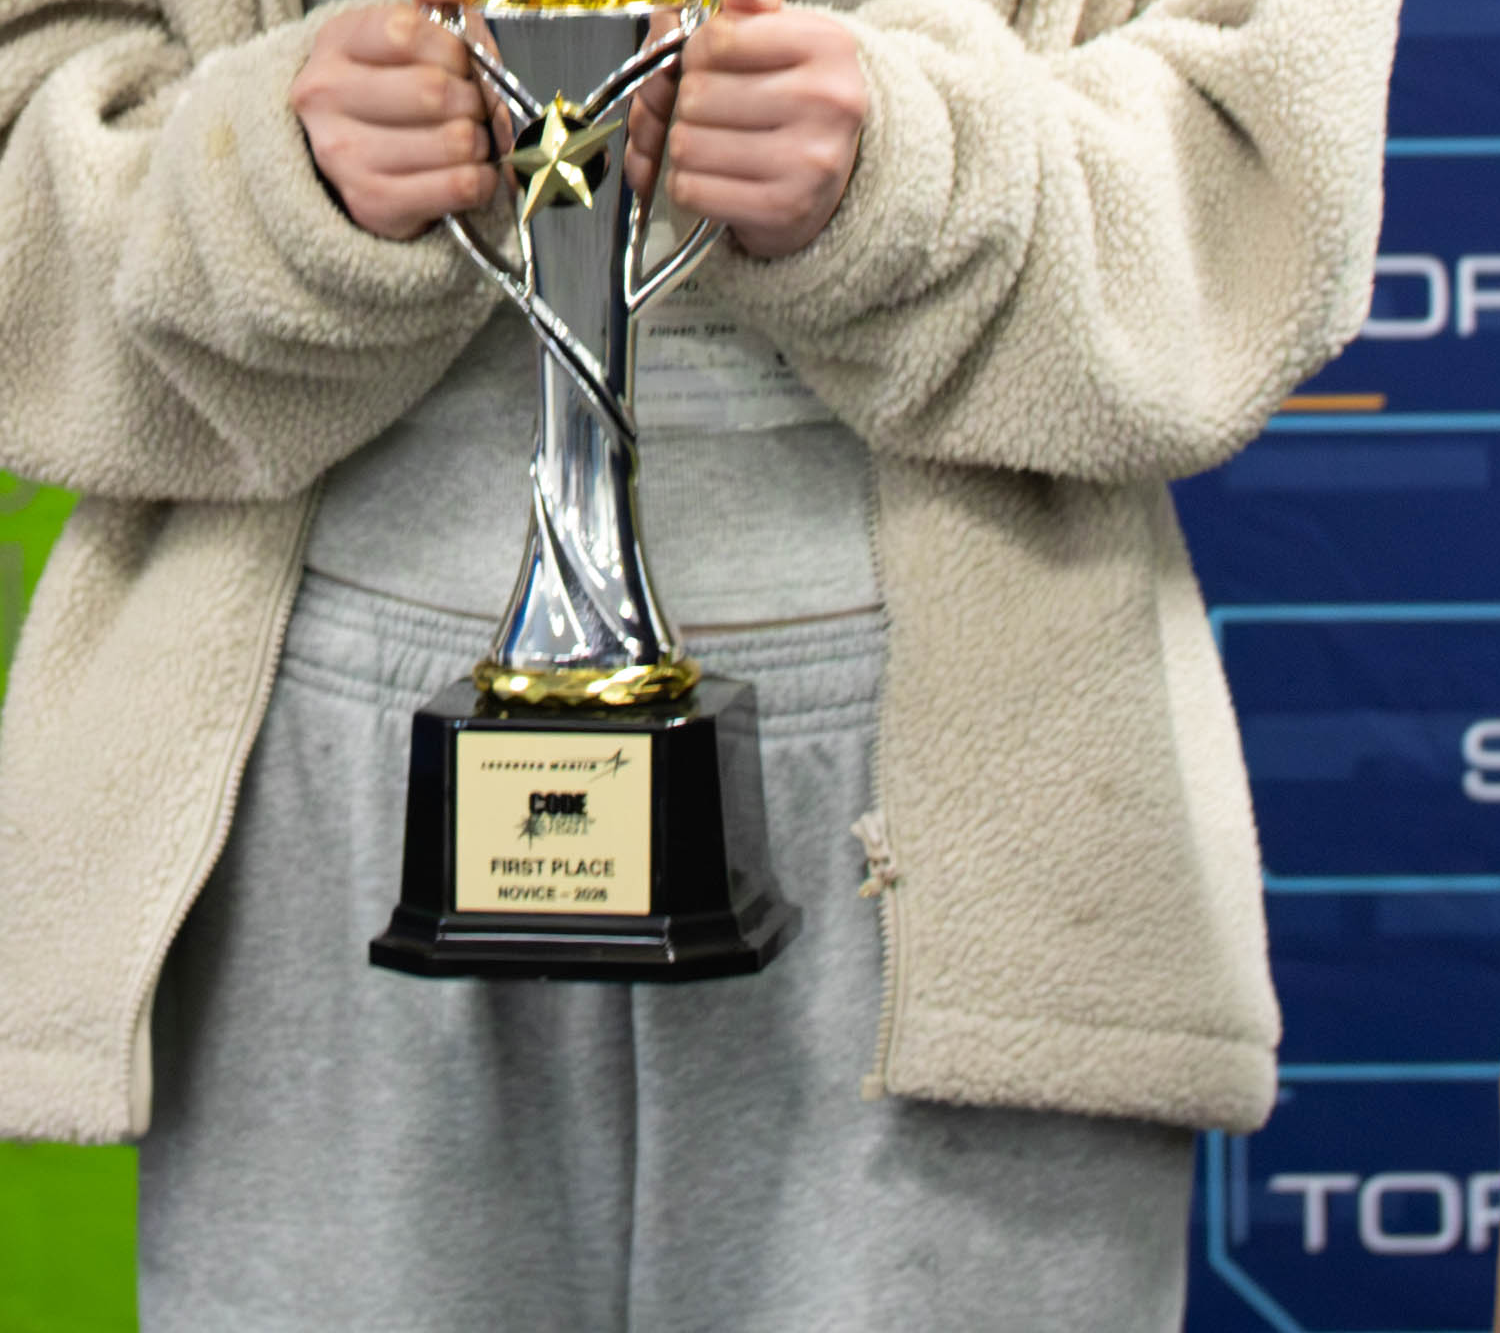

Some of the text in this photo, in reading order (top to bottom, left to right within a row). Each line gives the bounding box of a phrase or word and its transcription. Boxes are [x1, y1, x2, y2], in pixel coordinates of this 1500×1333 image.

[529, 791, 589, 816] CODE
[490, 857, 616, 878] FIRST PLACE
[497, 884, 557, 902] NOVICE
